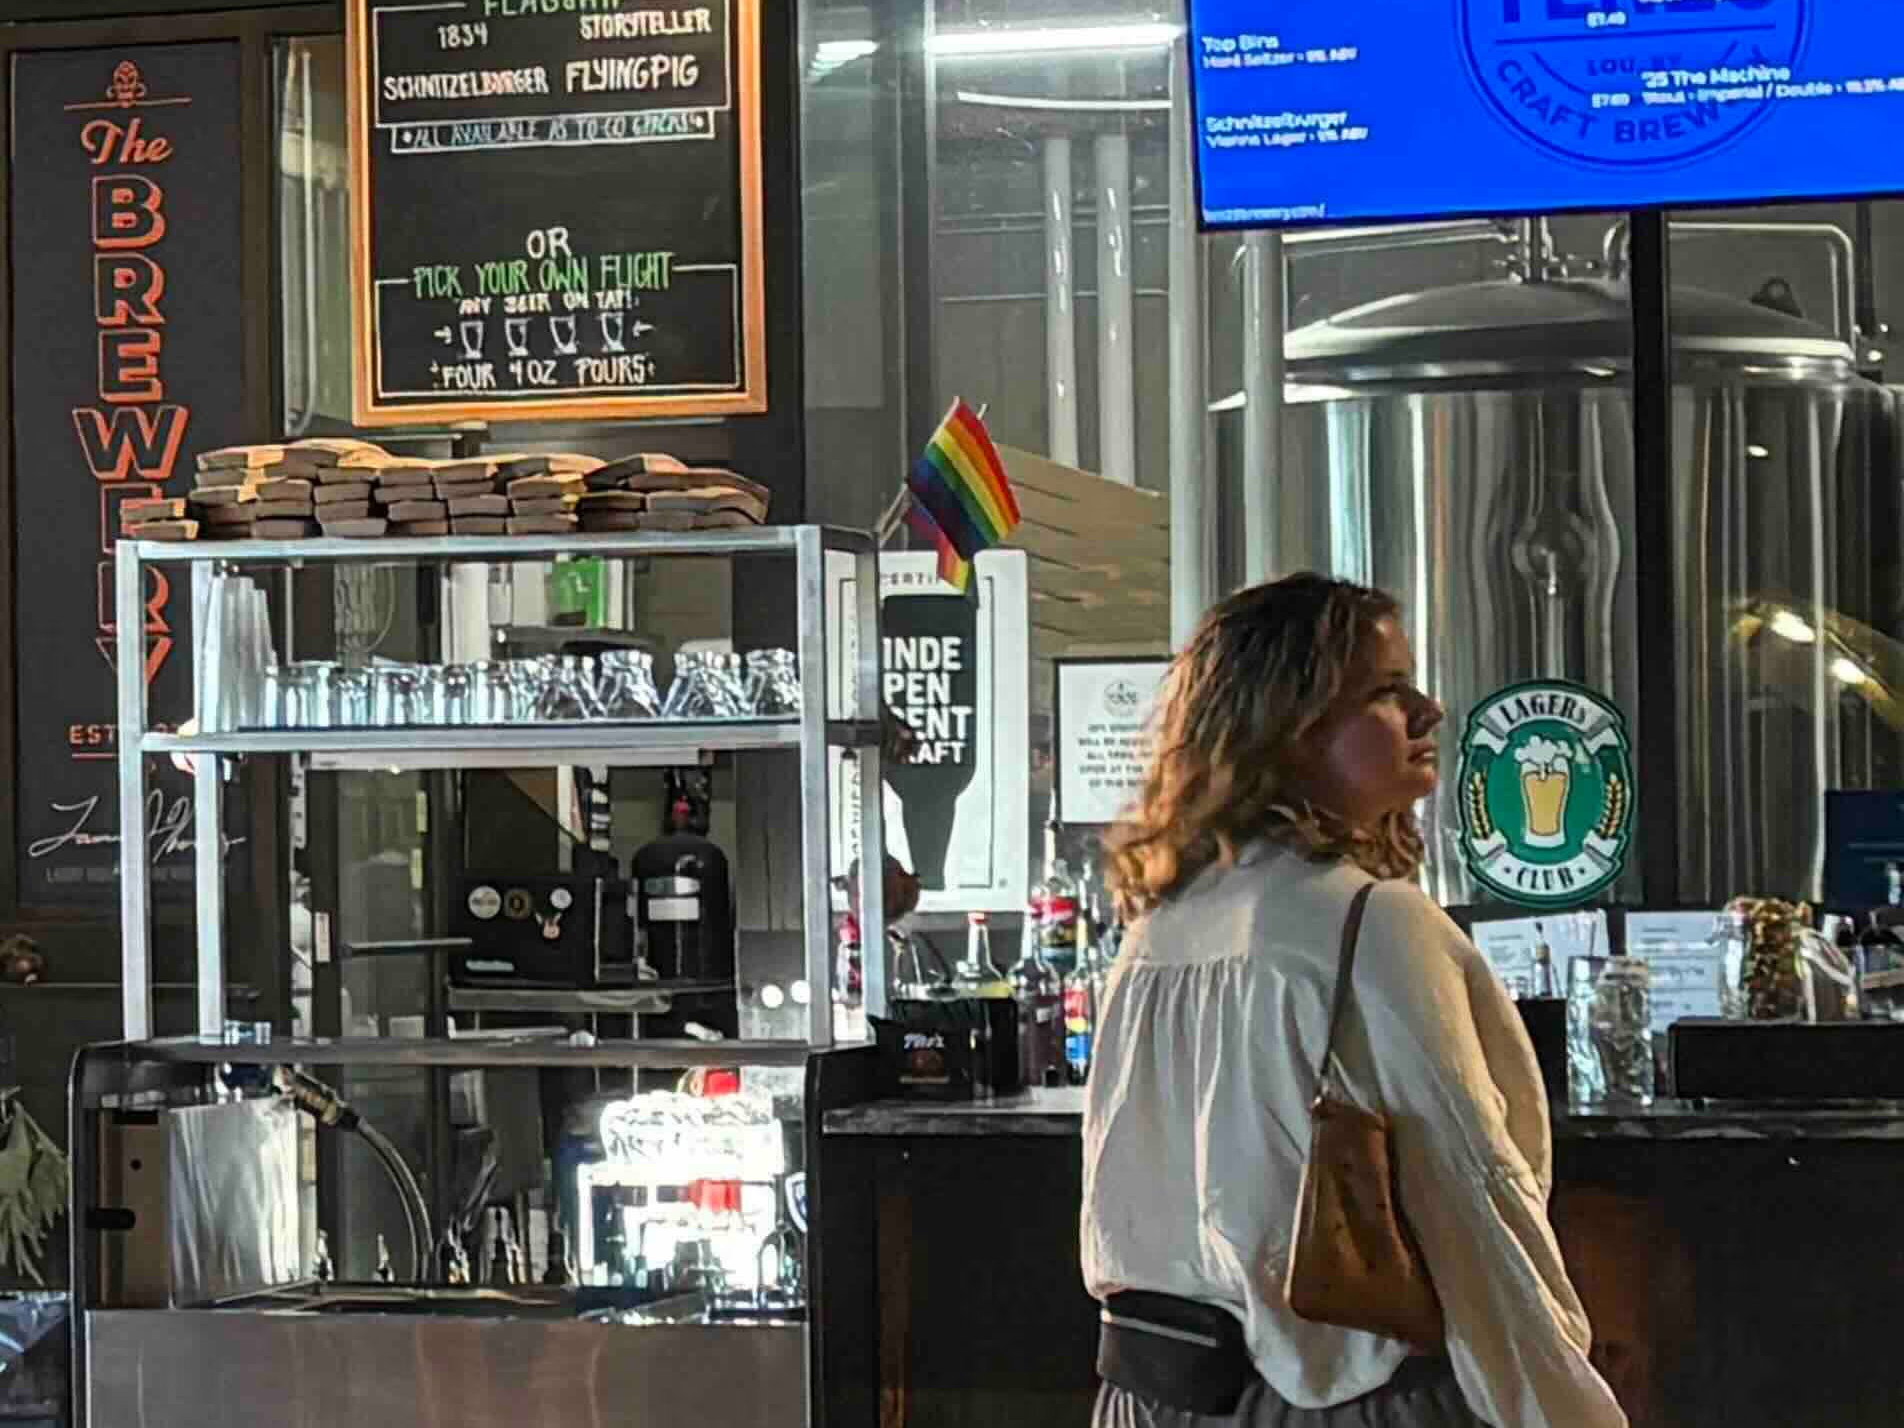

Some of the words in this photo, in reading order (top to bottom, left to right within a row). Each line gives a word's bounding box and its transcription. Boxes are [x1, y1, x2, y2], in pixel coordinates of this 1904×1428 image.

[438, 22, 488, 49] 1834
[580, 8, 711, 40] STORYTELLER
[384, 66, 549, 100] SCHNITZELBURGER
[1670, 70, 1706, 86] The
[1710, 64, 1790, 83] Machine
[1498, 59, 1597, 140] CRAFT
[81, 118, 173, 166] The
[526, 226, 572, 260] OR
[413, 265, 462, 299] PICK
[475, 259, 530, 295] YOUR
[539, 256, 588, 294] OWN
[600, 252, 674, 290] FLIGHT
[563, 291, 589, 311] ON
[442, 363, 496, 388] FOUR
[574, 356, 646, 385] POURS
[882, 636, 963, 671] INDE
[883, 673, 951, 708] PEN
[1499, 693, 1586, 725] LAGERS
[909, 741, 966, 763] AFT
[1516, 867, 1574, 890] CLUB
